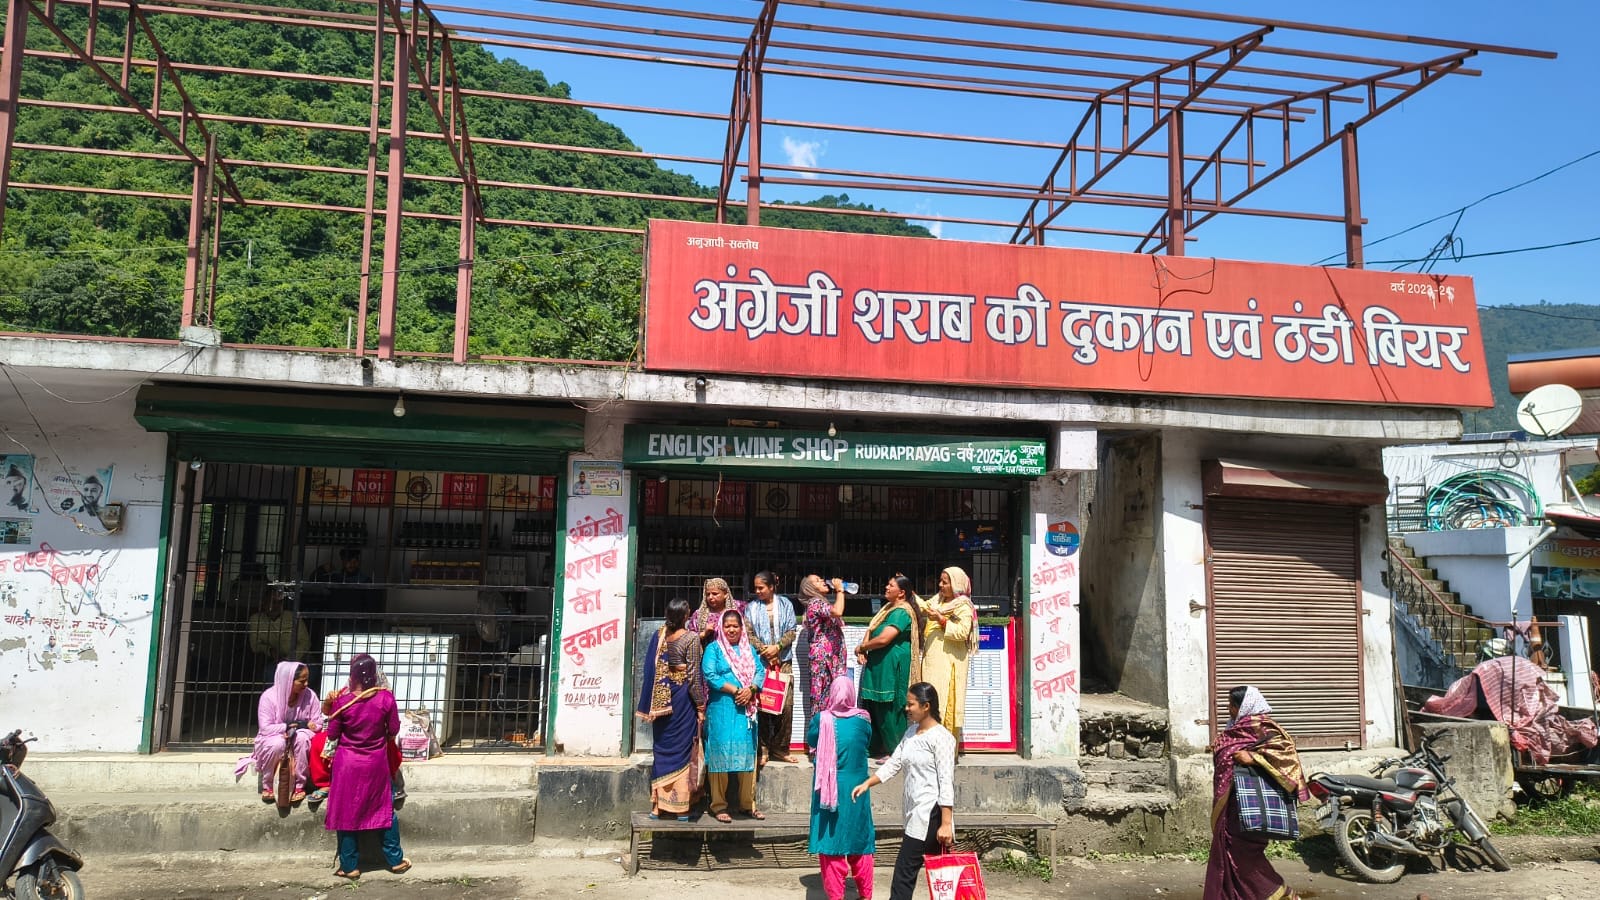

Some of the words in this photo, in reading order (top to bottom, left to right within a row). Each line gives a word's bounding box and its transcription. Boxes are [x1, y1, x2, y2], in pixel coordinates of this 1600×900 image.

[689, 264, 842, 340] अंग्रेजी
[853, 287, 975, 344] शराब
[985, 283, 1050, 347] की
[1060, 301, 1195, 365] दुकान
[1204, 297, 1263, 360] एवं
[1272, 301, 1355, 365] ठंडी
[1362, 305, 1470, 373] बियर
[648, 434, 725, 457] ENGLISH
[734, 436, 785, 460] WINE
[792, 437, 848, 462] SHOP
[566, 548, 618, 580] शराब
[568, 587, 602, 614] की
[1030, 590, 1071, 617] शराब
[562, 618, 620, 666] दुकान
[572, 673, 602, 687] Time
[1033, 670, 1078, 701] बियर
